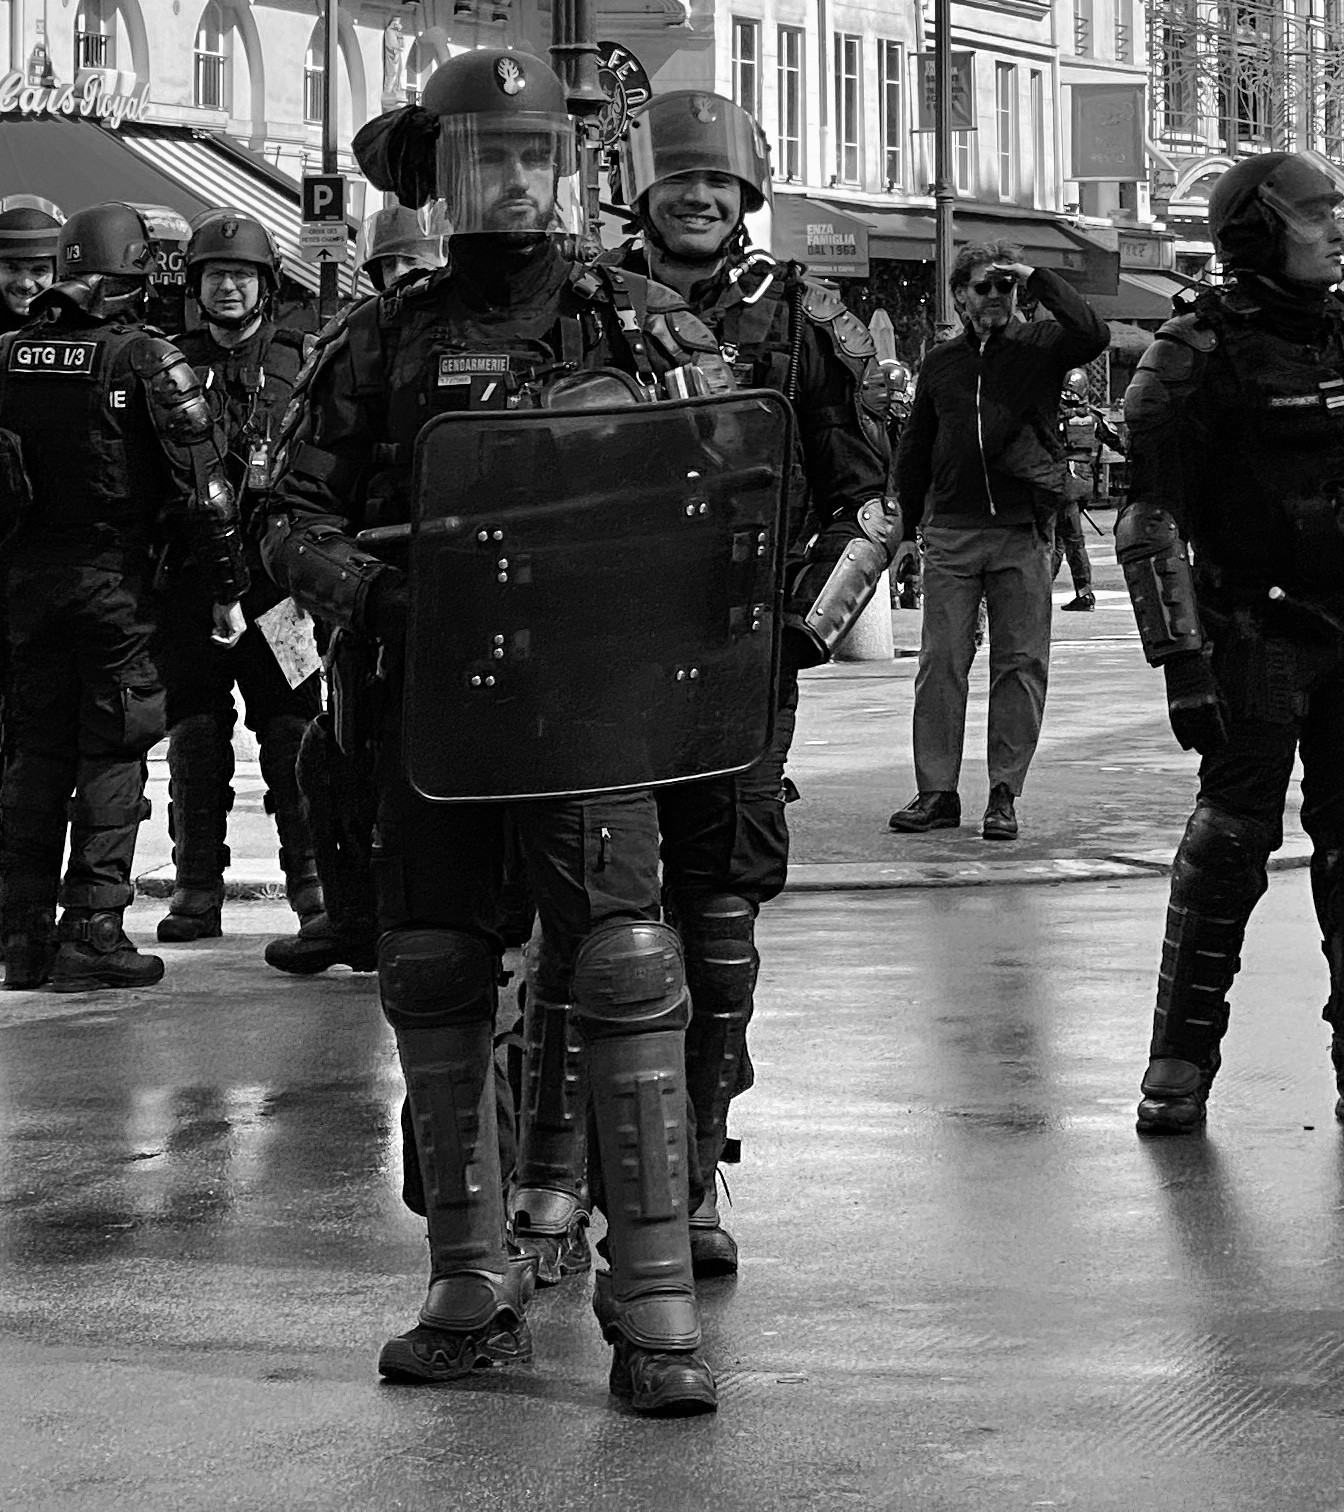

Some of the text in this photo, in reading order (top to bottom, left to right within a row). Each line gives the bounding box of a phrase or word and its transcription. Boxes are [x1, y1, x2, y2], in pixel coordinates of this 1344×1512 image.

[80, 74, 151, 129] Royal
[313, 184, 334, 215] P
[807, 224, 834, 235] ENZA
[807, 234, 856, 246] FAMIGLIA
[16, 346, 56, 365] GTG
[441, 358, 507, 373] GENDARMERIE
